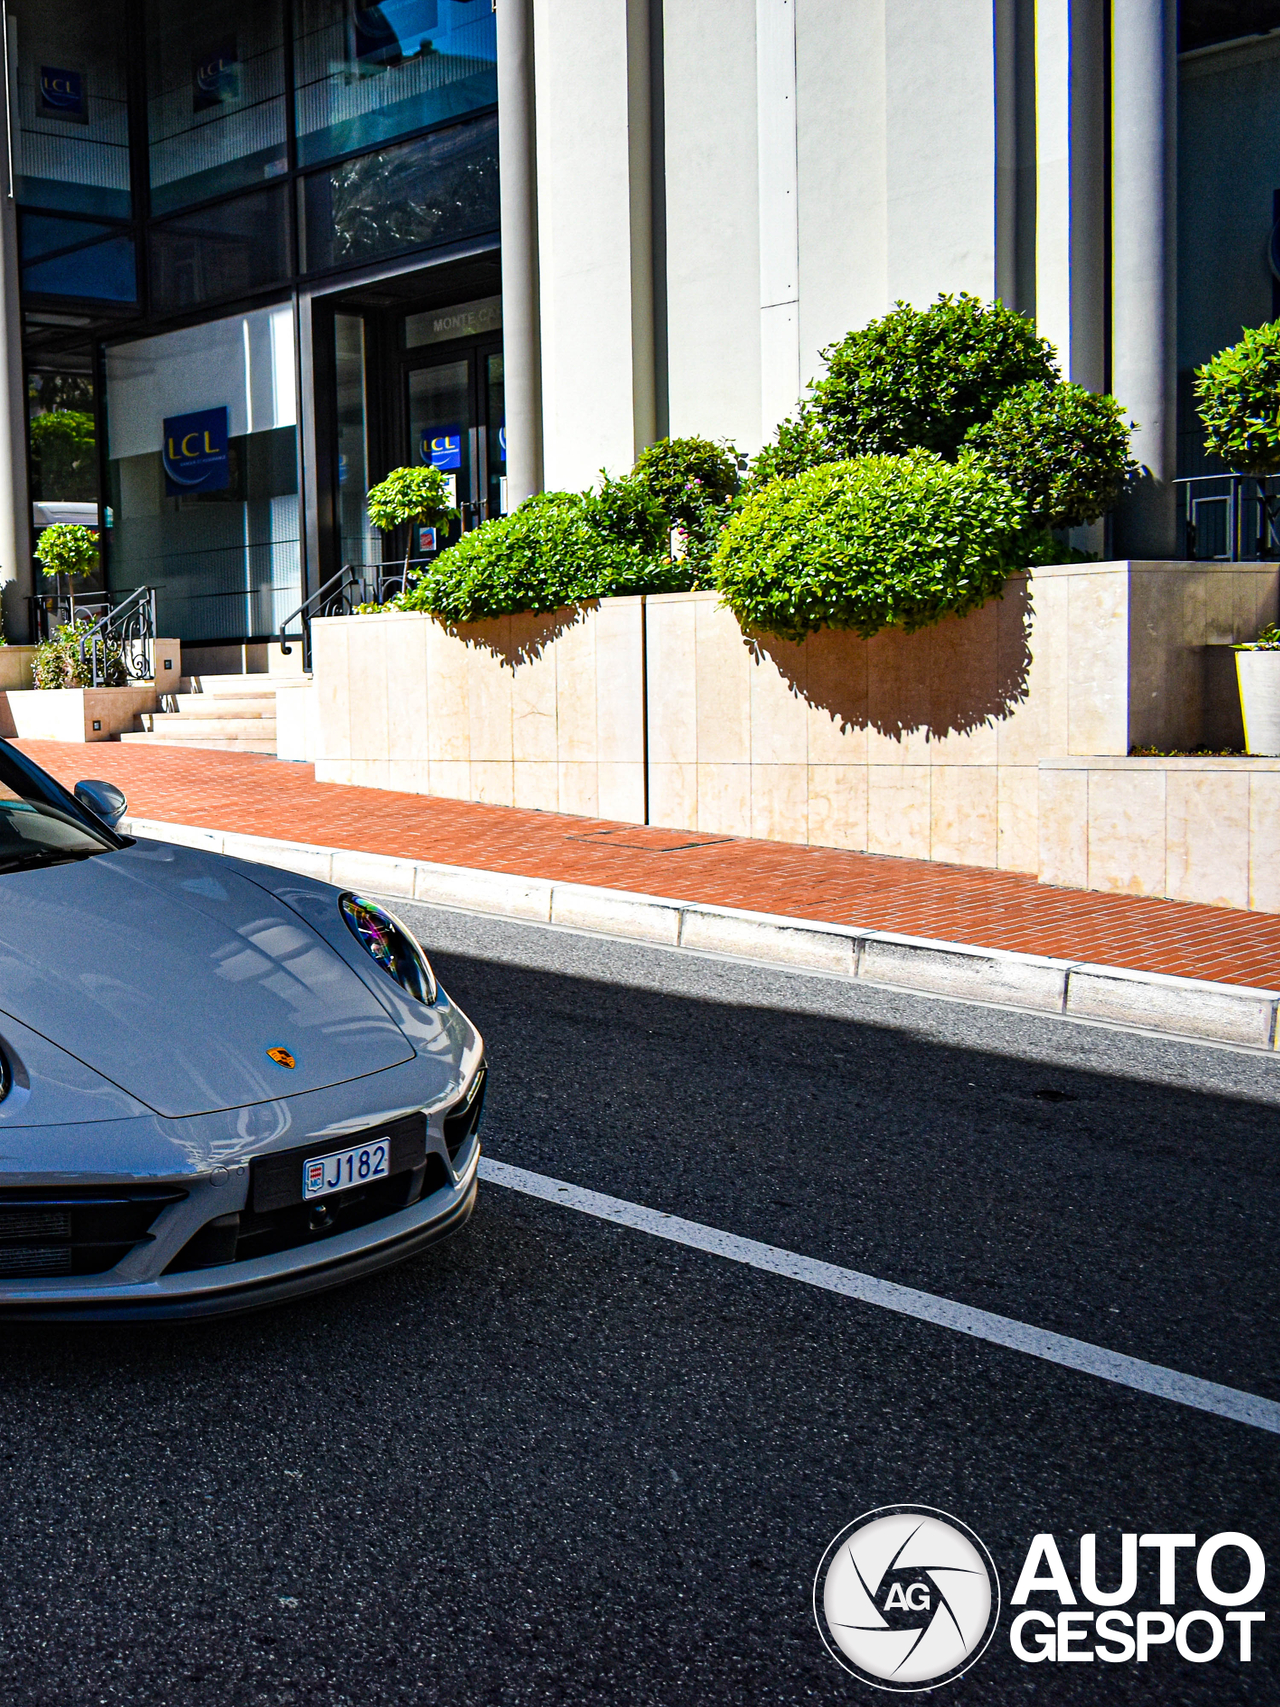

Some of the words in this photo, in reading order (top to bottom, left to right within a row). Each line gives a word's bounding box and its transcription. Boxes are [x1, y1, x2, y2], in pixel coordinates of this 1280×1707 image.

[200, 59, 226, 79] LCL
[44, 77, 77, 94] LCL
[433, 312, 475, 332] MONTE
[168, 431, 221, 460] LCL
[423, 436, 456, 453] LCL
[327, 1145, 385, 1188] J182
